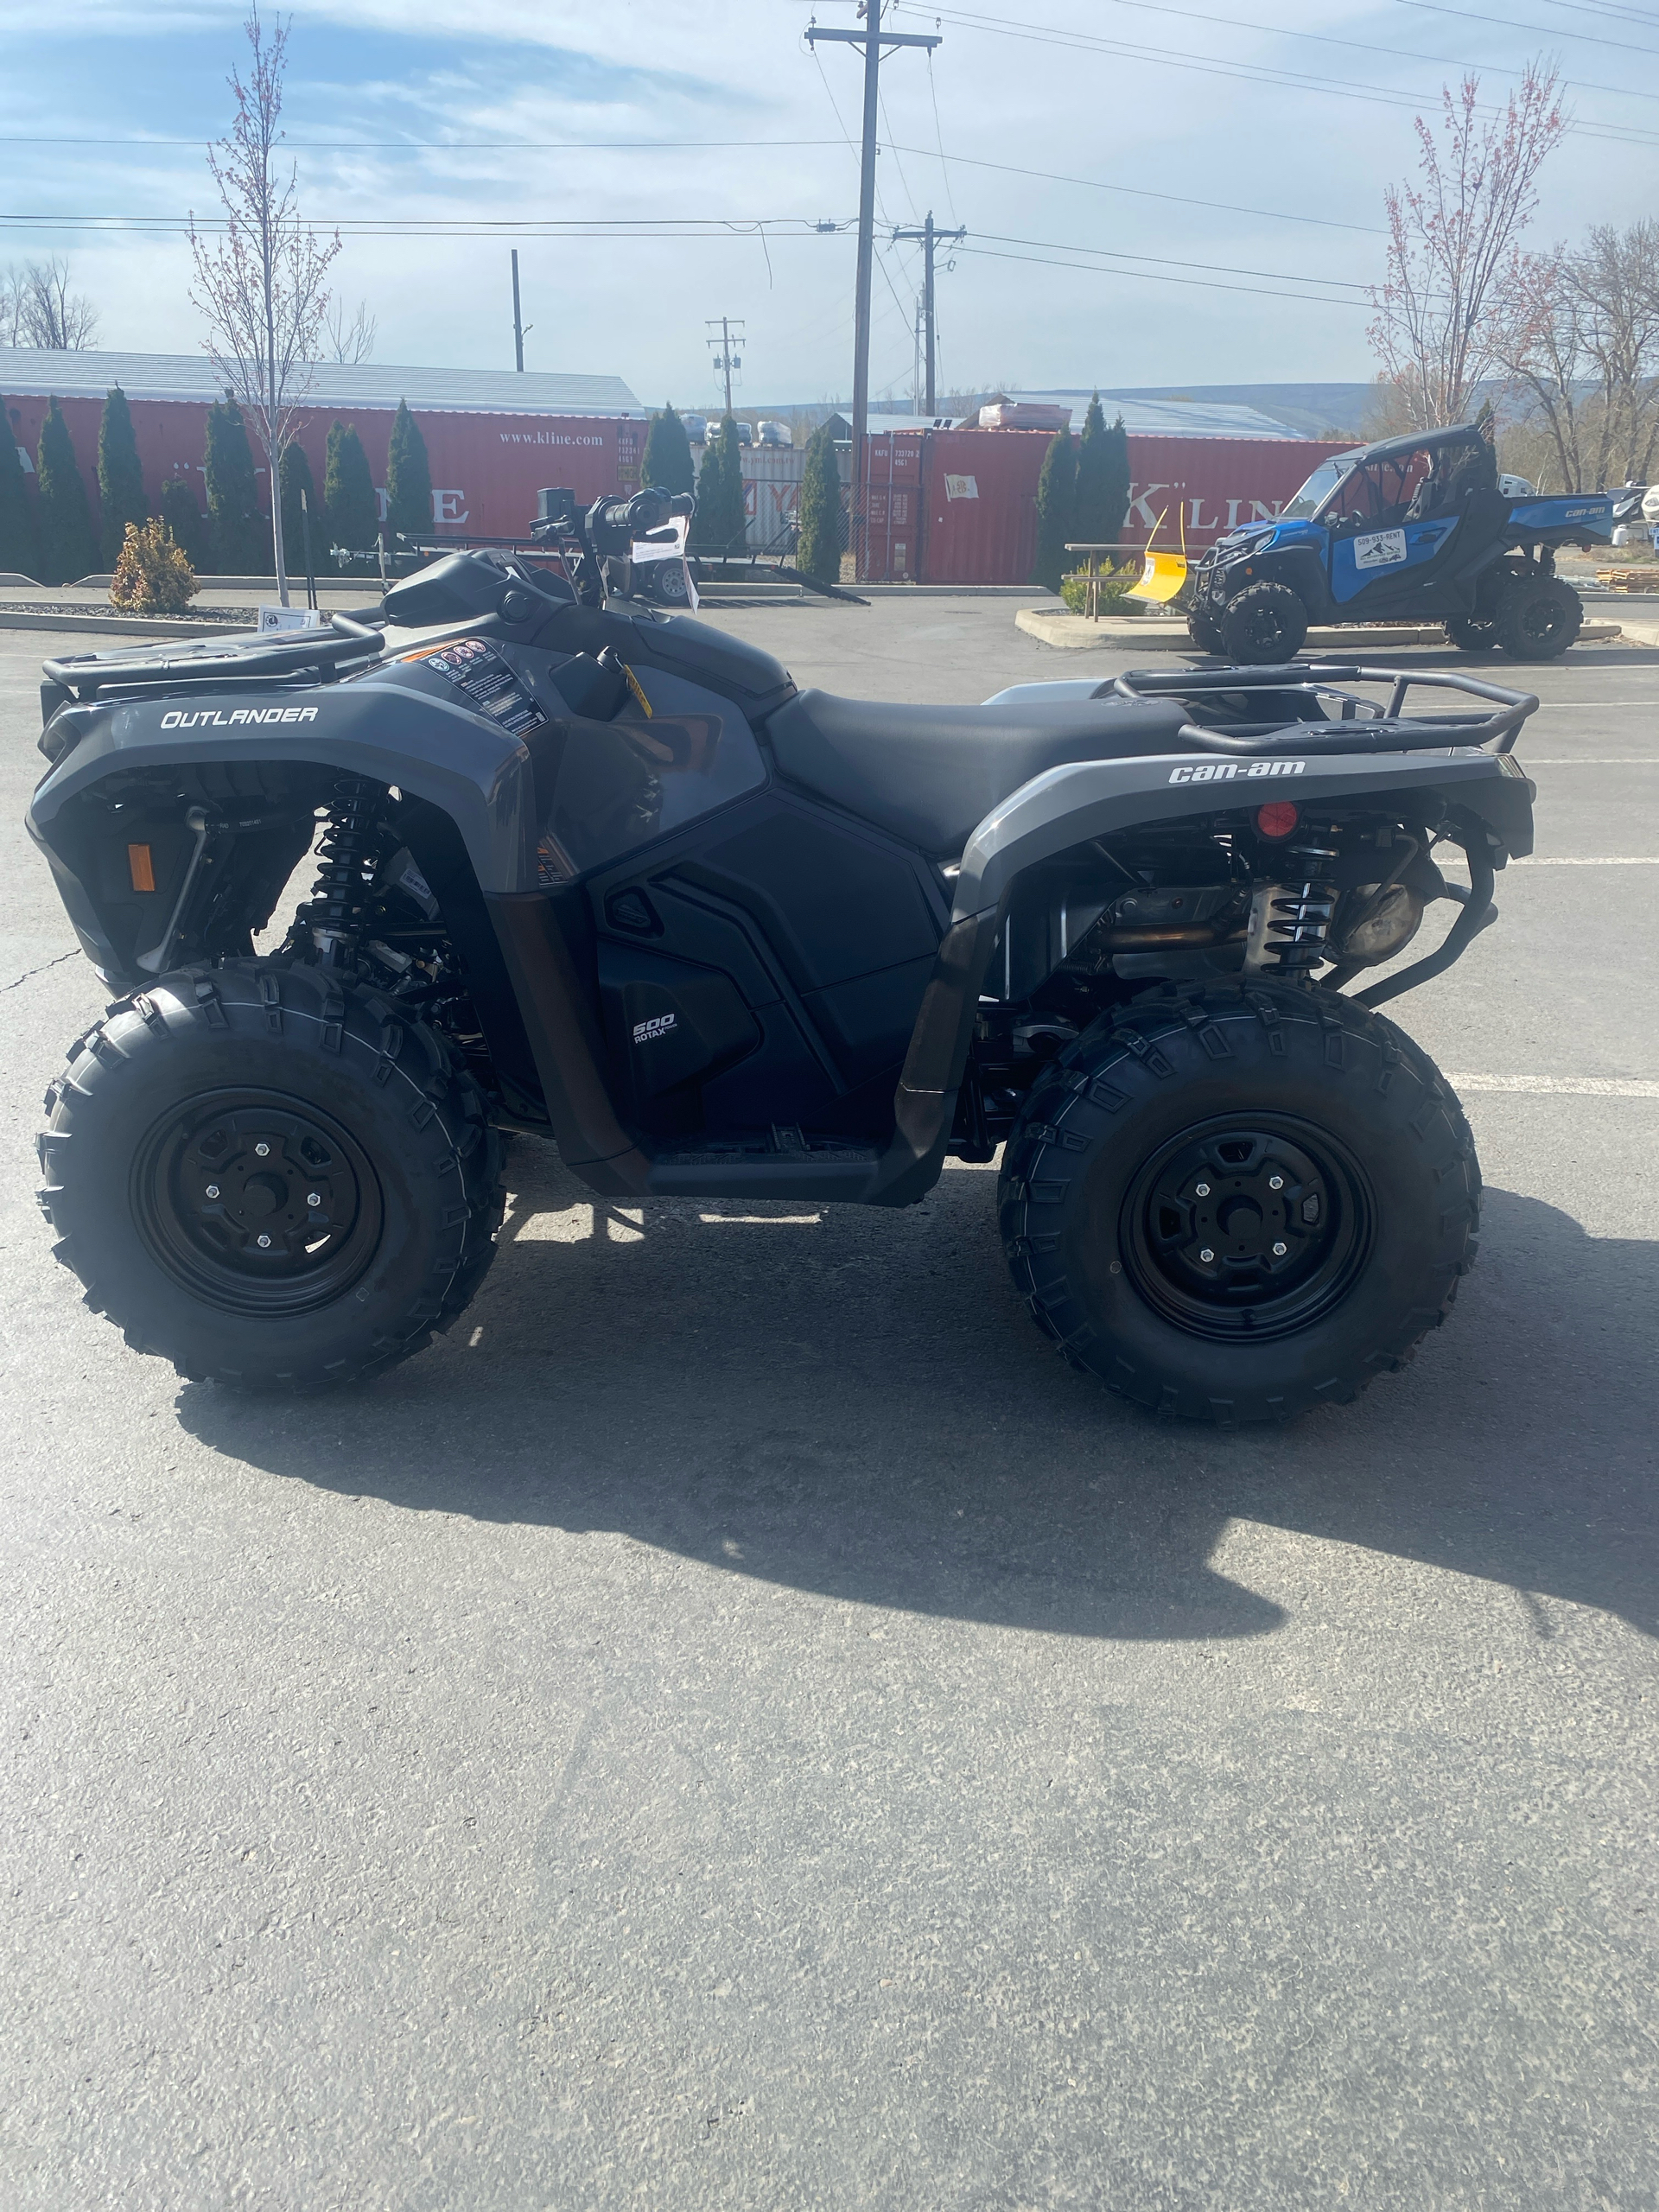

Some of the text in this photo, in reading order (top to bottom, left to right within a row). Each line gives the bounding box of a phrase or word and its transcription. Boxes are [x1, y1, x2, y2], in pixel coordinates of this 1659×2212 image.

[499, 431, 603, 446] www.kline.com
[895, 449, 914, 458] 733720
[1187, 499, 1287, 530] LIN
[1565, 506, 1605, 518] can-am
[1357, 531, 1401, 546] 509-933-RENT
[160, 707, 319, 729] OUTLANDER
[1168, 761, 1306, 784] can-am
[633, 1013, 675, 1036] 600
[634, 1027, 666, 1044] ROTAX
